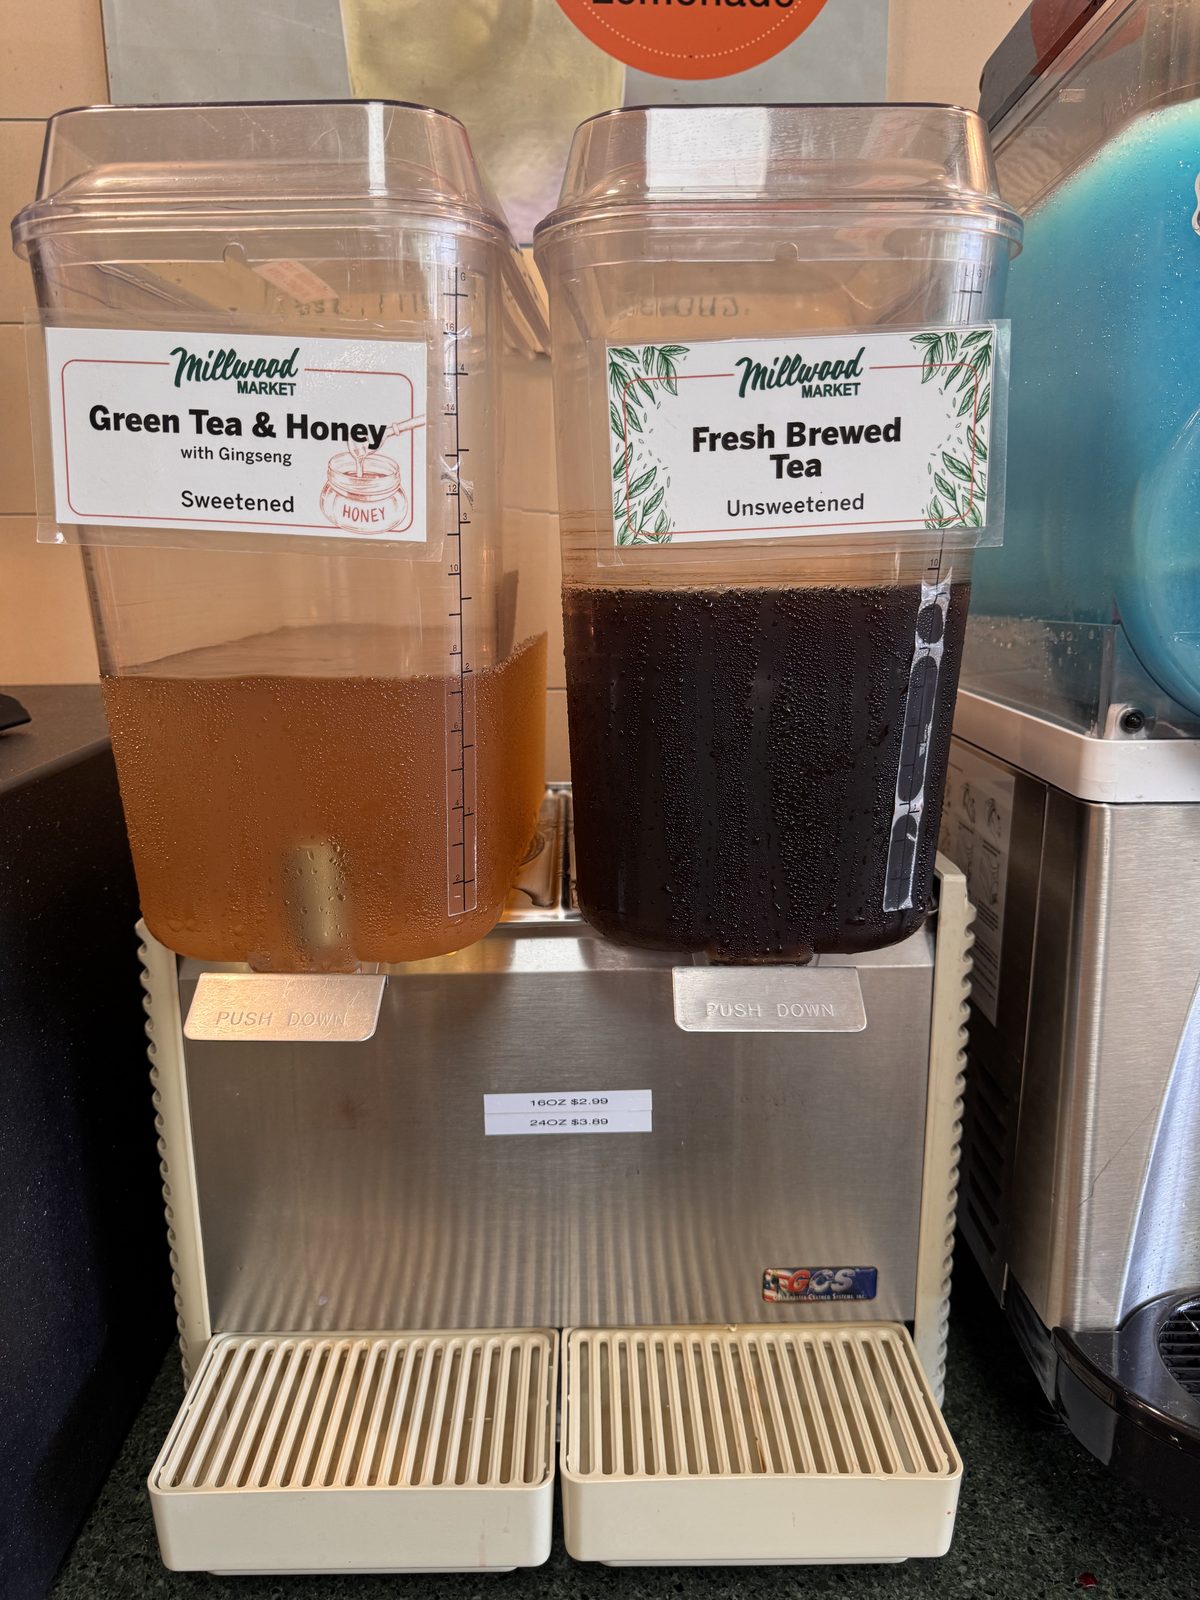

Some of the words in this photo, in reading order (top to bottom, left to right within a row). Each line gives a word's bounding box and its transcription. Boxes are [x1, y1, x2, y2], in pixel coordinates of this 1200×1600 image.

[170, 347, 300, 387] Millwood
[734, 346, 865, 398] Millwood
[237, 380, 296, 396] MARKET
[801, 382, 861, 399] MARKET
[89, 404, 180, 434] Green
[189, 409, 242, 436] Tea
[252, 412, 276, 438] &
[287, 414, 387, 450] Honey
[692, 424, 775, 453] Fresh
[786, 416, 902, 447] Brewed
[180, 446, 214, 461] with
[218, 448, 292, 467] Gingseng
[770, 453, 822, 480] Tea
[448, 485, 457, 493] 12
[181, 490, 294, 513] Sweetened
[727, 493, 865, 517] Unsweetened
[342, 504, 386, 523] HONEY
[450, 564, 459, 572] 10
[930, 558, 939, 566] 10
[215, 1011, 274, 1026] PUSH
[287, 1011, 348, 1027] DOWN
[706, 1002, 761, 1018] PUSH
[777, 1003, 835, 1018] DOWN
[530, 1099, 567, 1107] 16OZ
[571, 1097, 609, 1106] $2.99
[530, 1119, 567, 1127] 24OZ
[571, 1117, 609, 1126] $3.89
